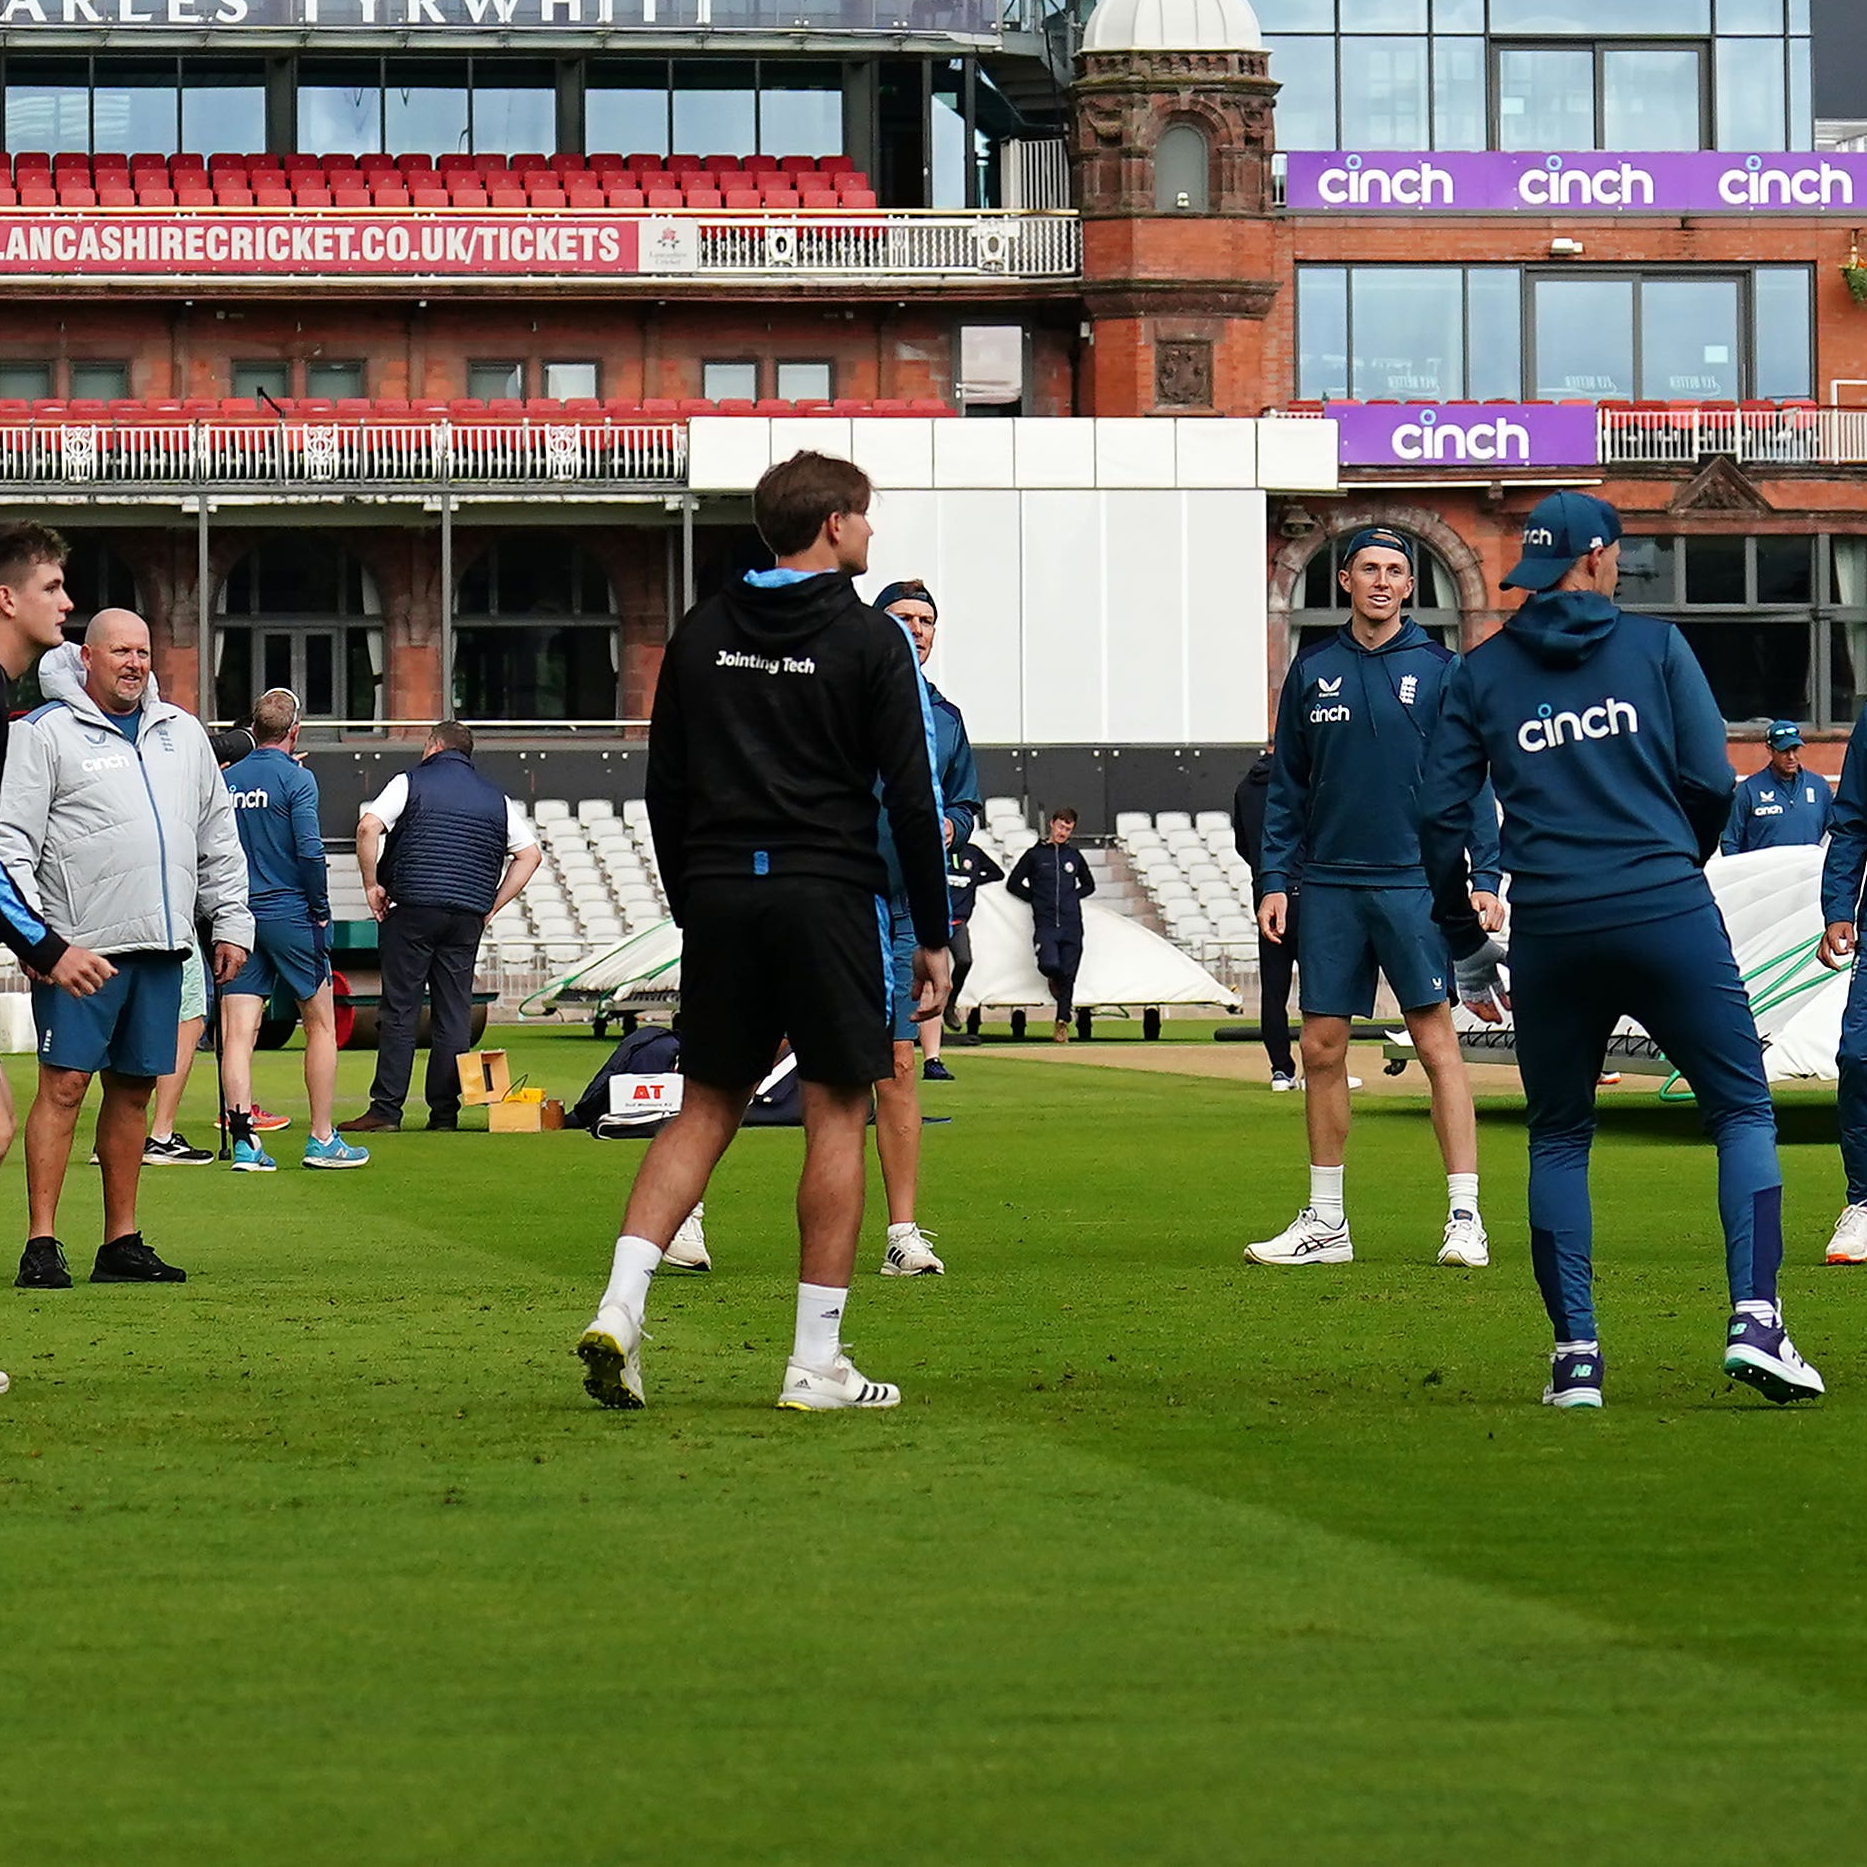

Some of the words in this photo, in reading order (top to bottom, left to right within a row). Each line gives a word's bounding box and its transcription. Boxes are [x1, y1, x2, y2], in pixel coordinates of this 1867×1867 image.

[1318, 154, 1454, 204] cinch
[1519, 154, 1655, 204] cinch
[1718, 154, 1853, 205] cinch
[1391, 409, 1530, 460] cinch
[715, 650, 780, 675] Jointing
[782, 657, 816, 675] Tech
[1310, 703, 1350, 724] cinch
[1518, 698, 1638, 753] cinch
[82, 753, 131, 773] cinch
[229, 784, 268, 810] inch
[632, 1084, 665, 1100] AT
[1570, 1364, 1594, 1379] NB
